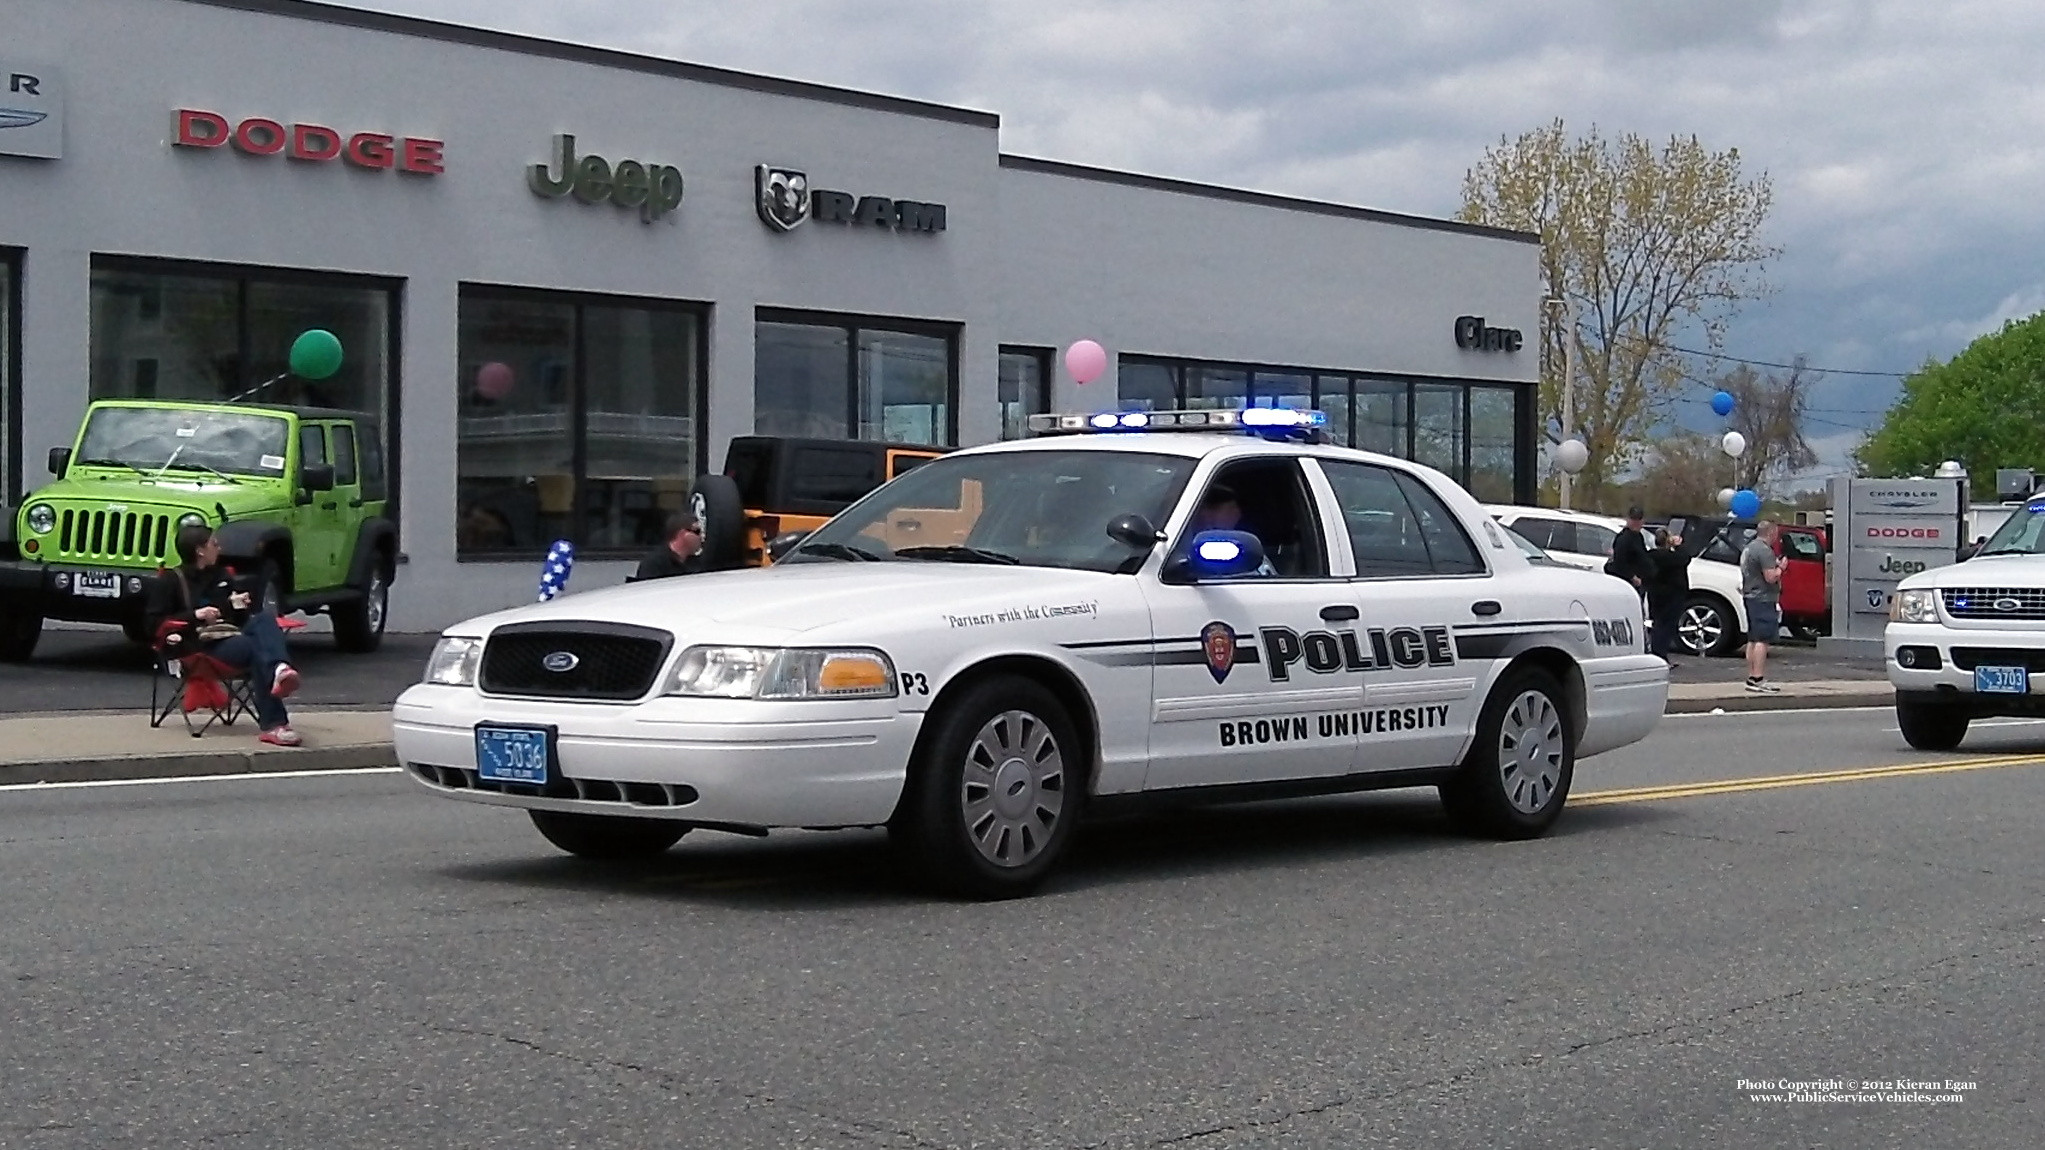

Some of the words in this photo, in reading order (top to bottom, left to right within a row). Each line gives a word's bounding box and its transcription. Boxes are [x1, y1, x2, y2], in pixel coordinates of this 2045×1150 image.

[171, 109, 445, 174] DODGE
[527, 133, 685, 224] Jeep
[811, 190, 947, 231] RAM
[1867, 527, 1939, 538] DODGE
[1879, 555, 1926, 574] Jeep
[998, 608, 1023, 624] with
[1024, 604, 1041, 621] the
[1258, 625, 1455, 682] POLICE
[900, 672, 930, 696] P3
[1995, 671, 2022, 687] 3703
[1219, 716, 1308, 747] BROWN
[1318, 704, 1449, 738] UNIVERSITY
[504, 741, 543, 769] 5036
